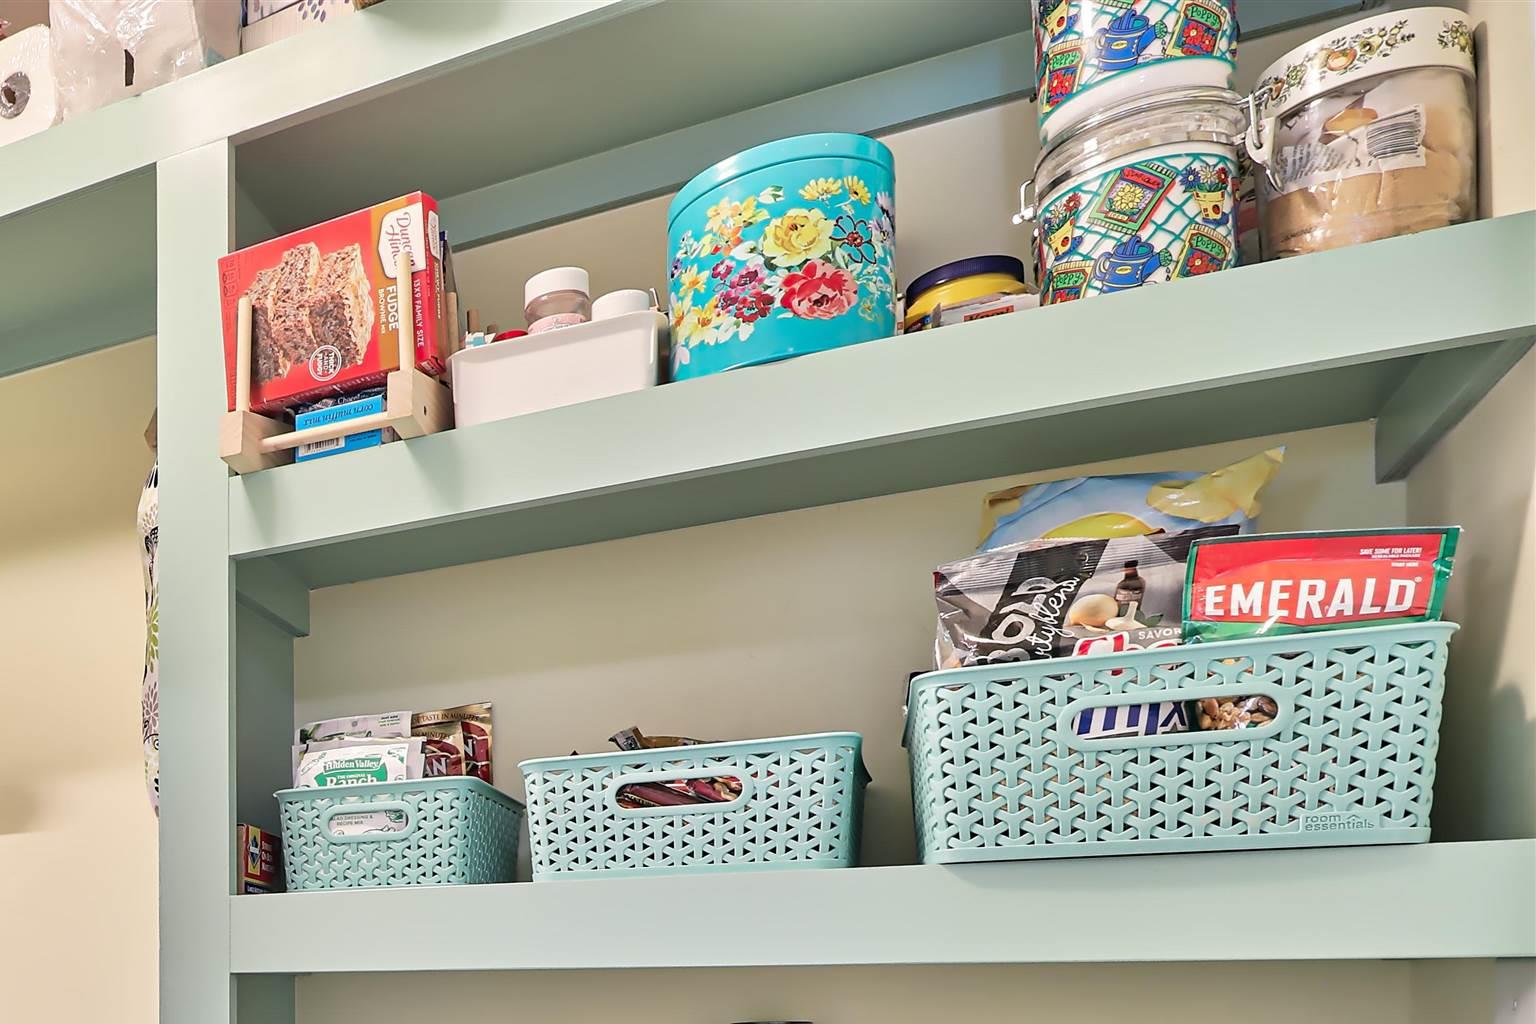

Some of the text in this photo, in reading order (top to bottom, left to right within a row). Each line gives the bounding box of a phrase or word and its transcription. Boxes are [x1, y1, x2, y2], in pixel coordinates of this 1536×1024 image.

[386, 286, 399, 331] FUDGE
[416, 301, 424, 328] FAMILY
[417, 330, 425, 347] SIZE
[303, 403, 374, 426] corn muffin mix
[1204, 577, 1419, 620] EMERALD
[421, 713, 441, 723] TASTE
[325, 759, 380, 771] Hidden Valley
[326, 774, 377, 787] Ranch
[1305, 815, 1341, 823] room
[1305, 819, 1375, 831] essentials
